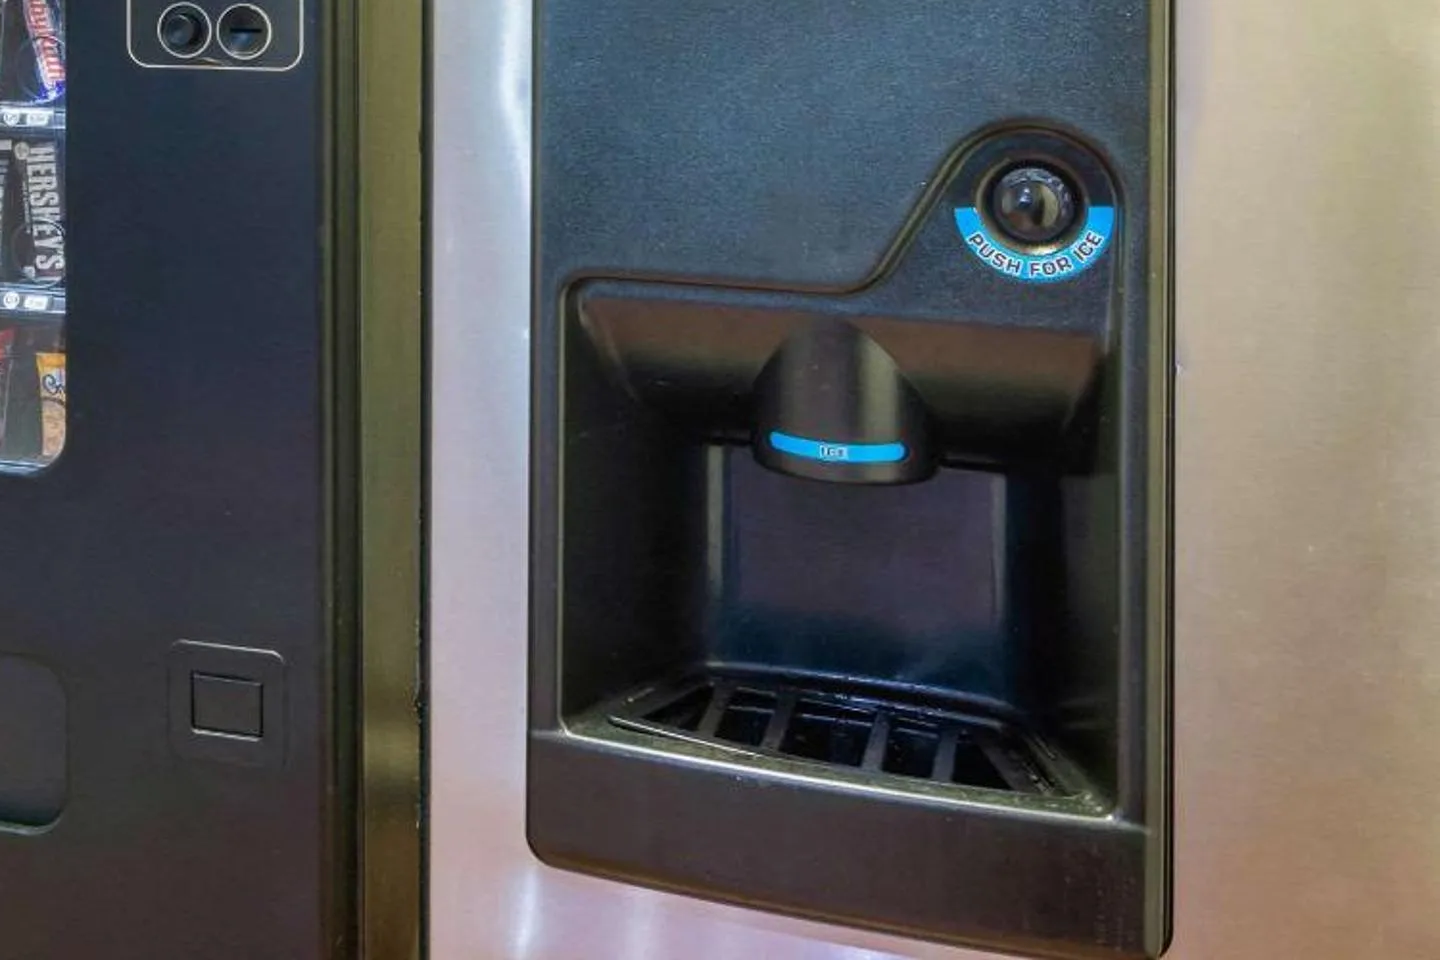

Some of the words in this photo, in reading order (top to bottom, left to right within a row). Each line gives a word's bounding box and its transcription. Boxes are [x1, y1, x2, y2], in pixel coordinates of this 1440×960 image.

[968, 232, 1022, 275] PUSH
[1029, 257, 1074, 278] FOR
[1072, 231, 1103, 263] ICE
